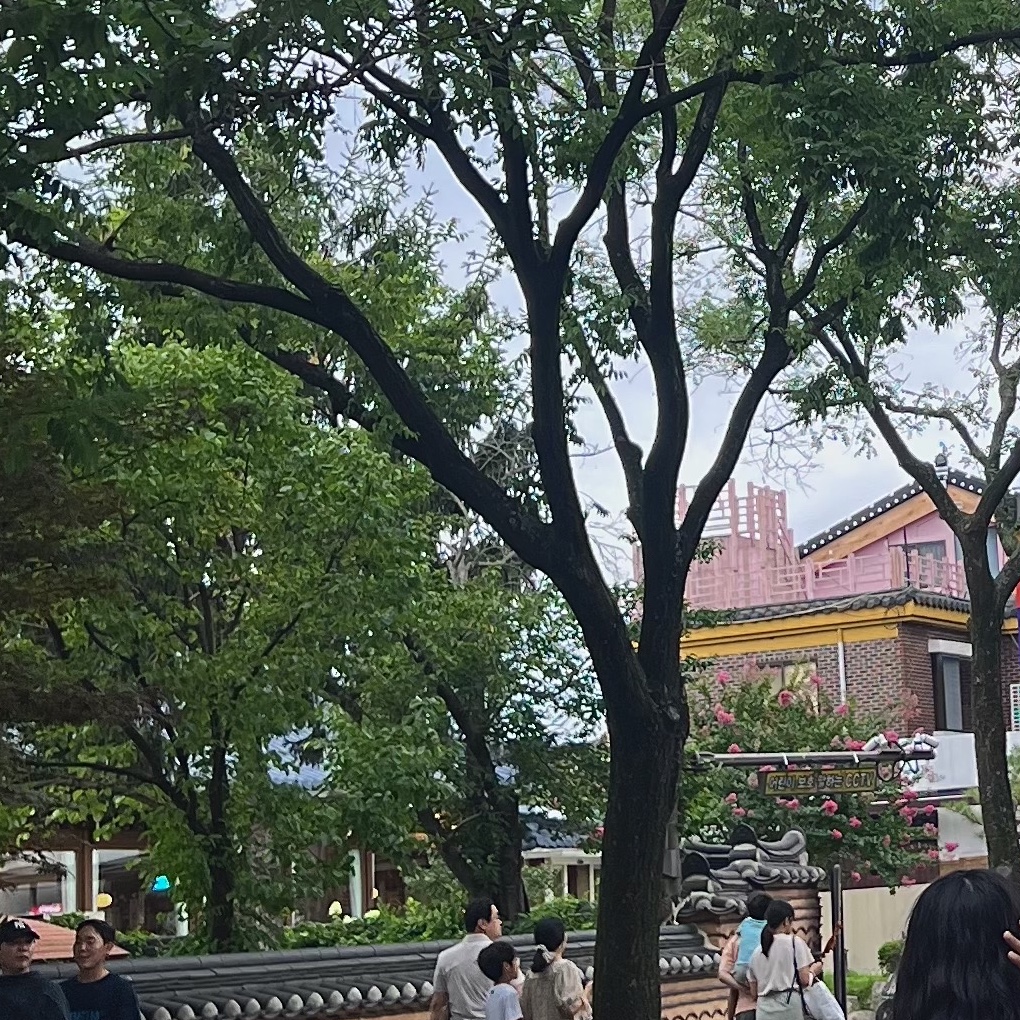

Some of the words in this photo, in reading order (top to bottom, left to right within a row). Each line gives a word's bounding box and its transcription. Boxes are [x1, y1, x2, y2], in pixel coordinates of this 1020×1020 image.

[769, 774, 795, 790] 어린이
[798, 774, 814, 789] 보호
[845, 772, 873, 788] CCTV
